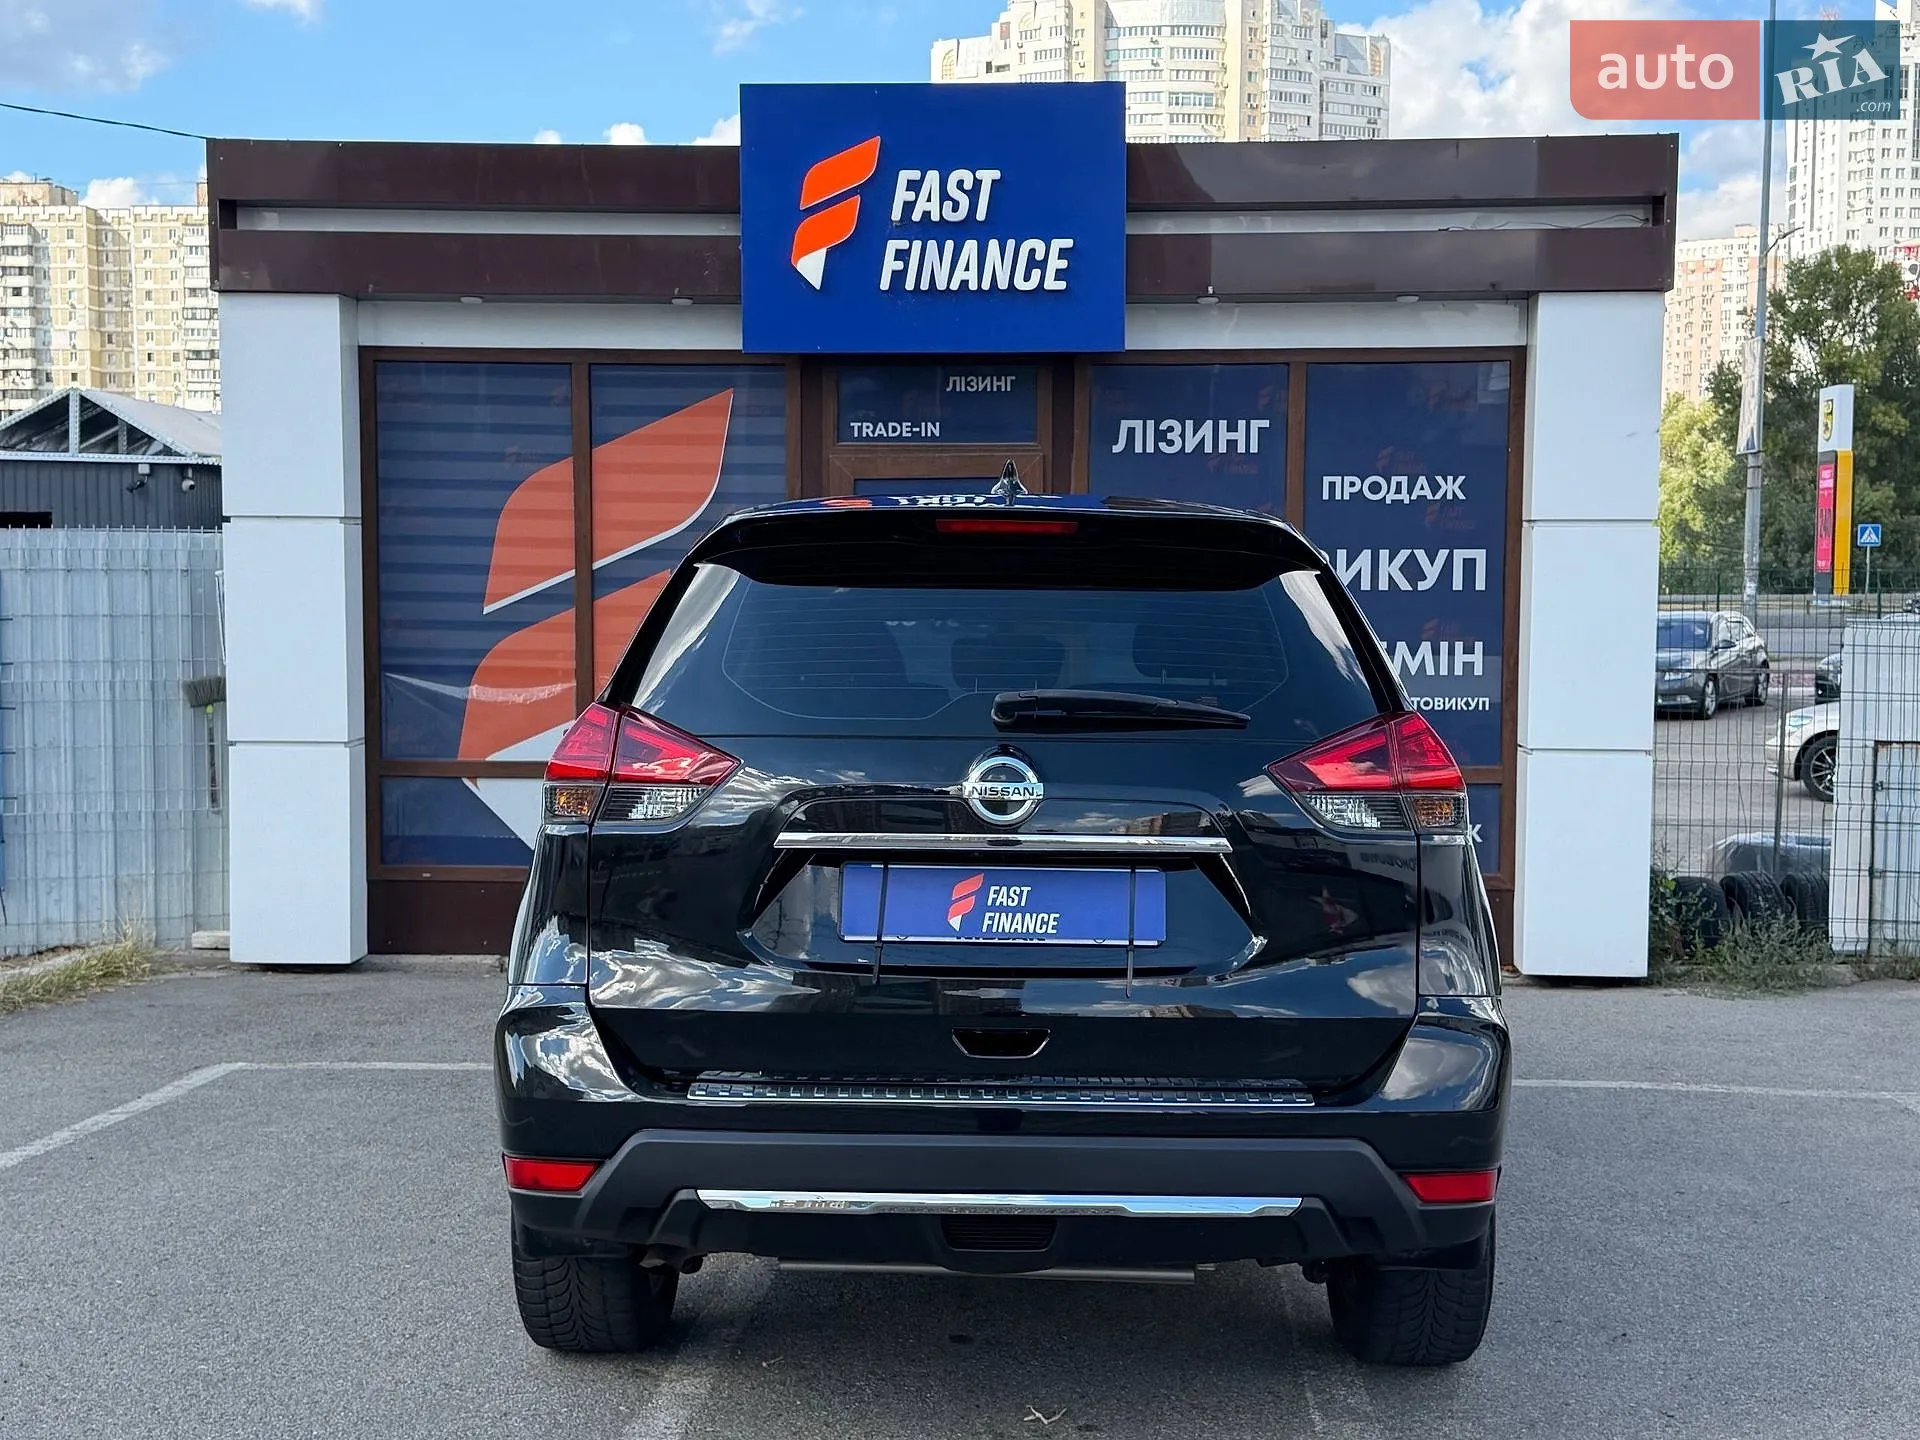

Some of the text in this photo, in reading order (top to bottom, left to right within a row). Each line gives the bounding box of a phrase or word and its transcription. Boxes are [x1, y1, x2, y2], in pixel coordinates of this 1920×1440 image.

[891, 169, 1001, 222] FAST
[879, 238, 1074, 291] FINANCE
[946, 375, 1016, 392] ЛІЗИНГ
[850, 421, 941, 438] TRADE-IN
[1112, 419, 1270, 454] ЛІЗИНГ
[1322, 475, 1467, 504] ПРОДАЖ
[1336, 549, 1487, 591] ИКУП
[1383, 641, 1484, 676] МІН
[1411, 697, 1490, 711] ТОВИКУП
[972, 786, 1036, 797] NISSAN
[987, 886, 1032, 907] FAST
[982, 913, 1060, 934] FINANCE
